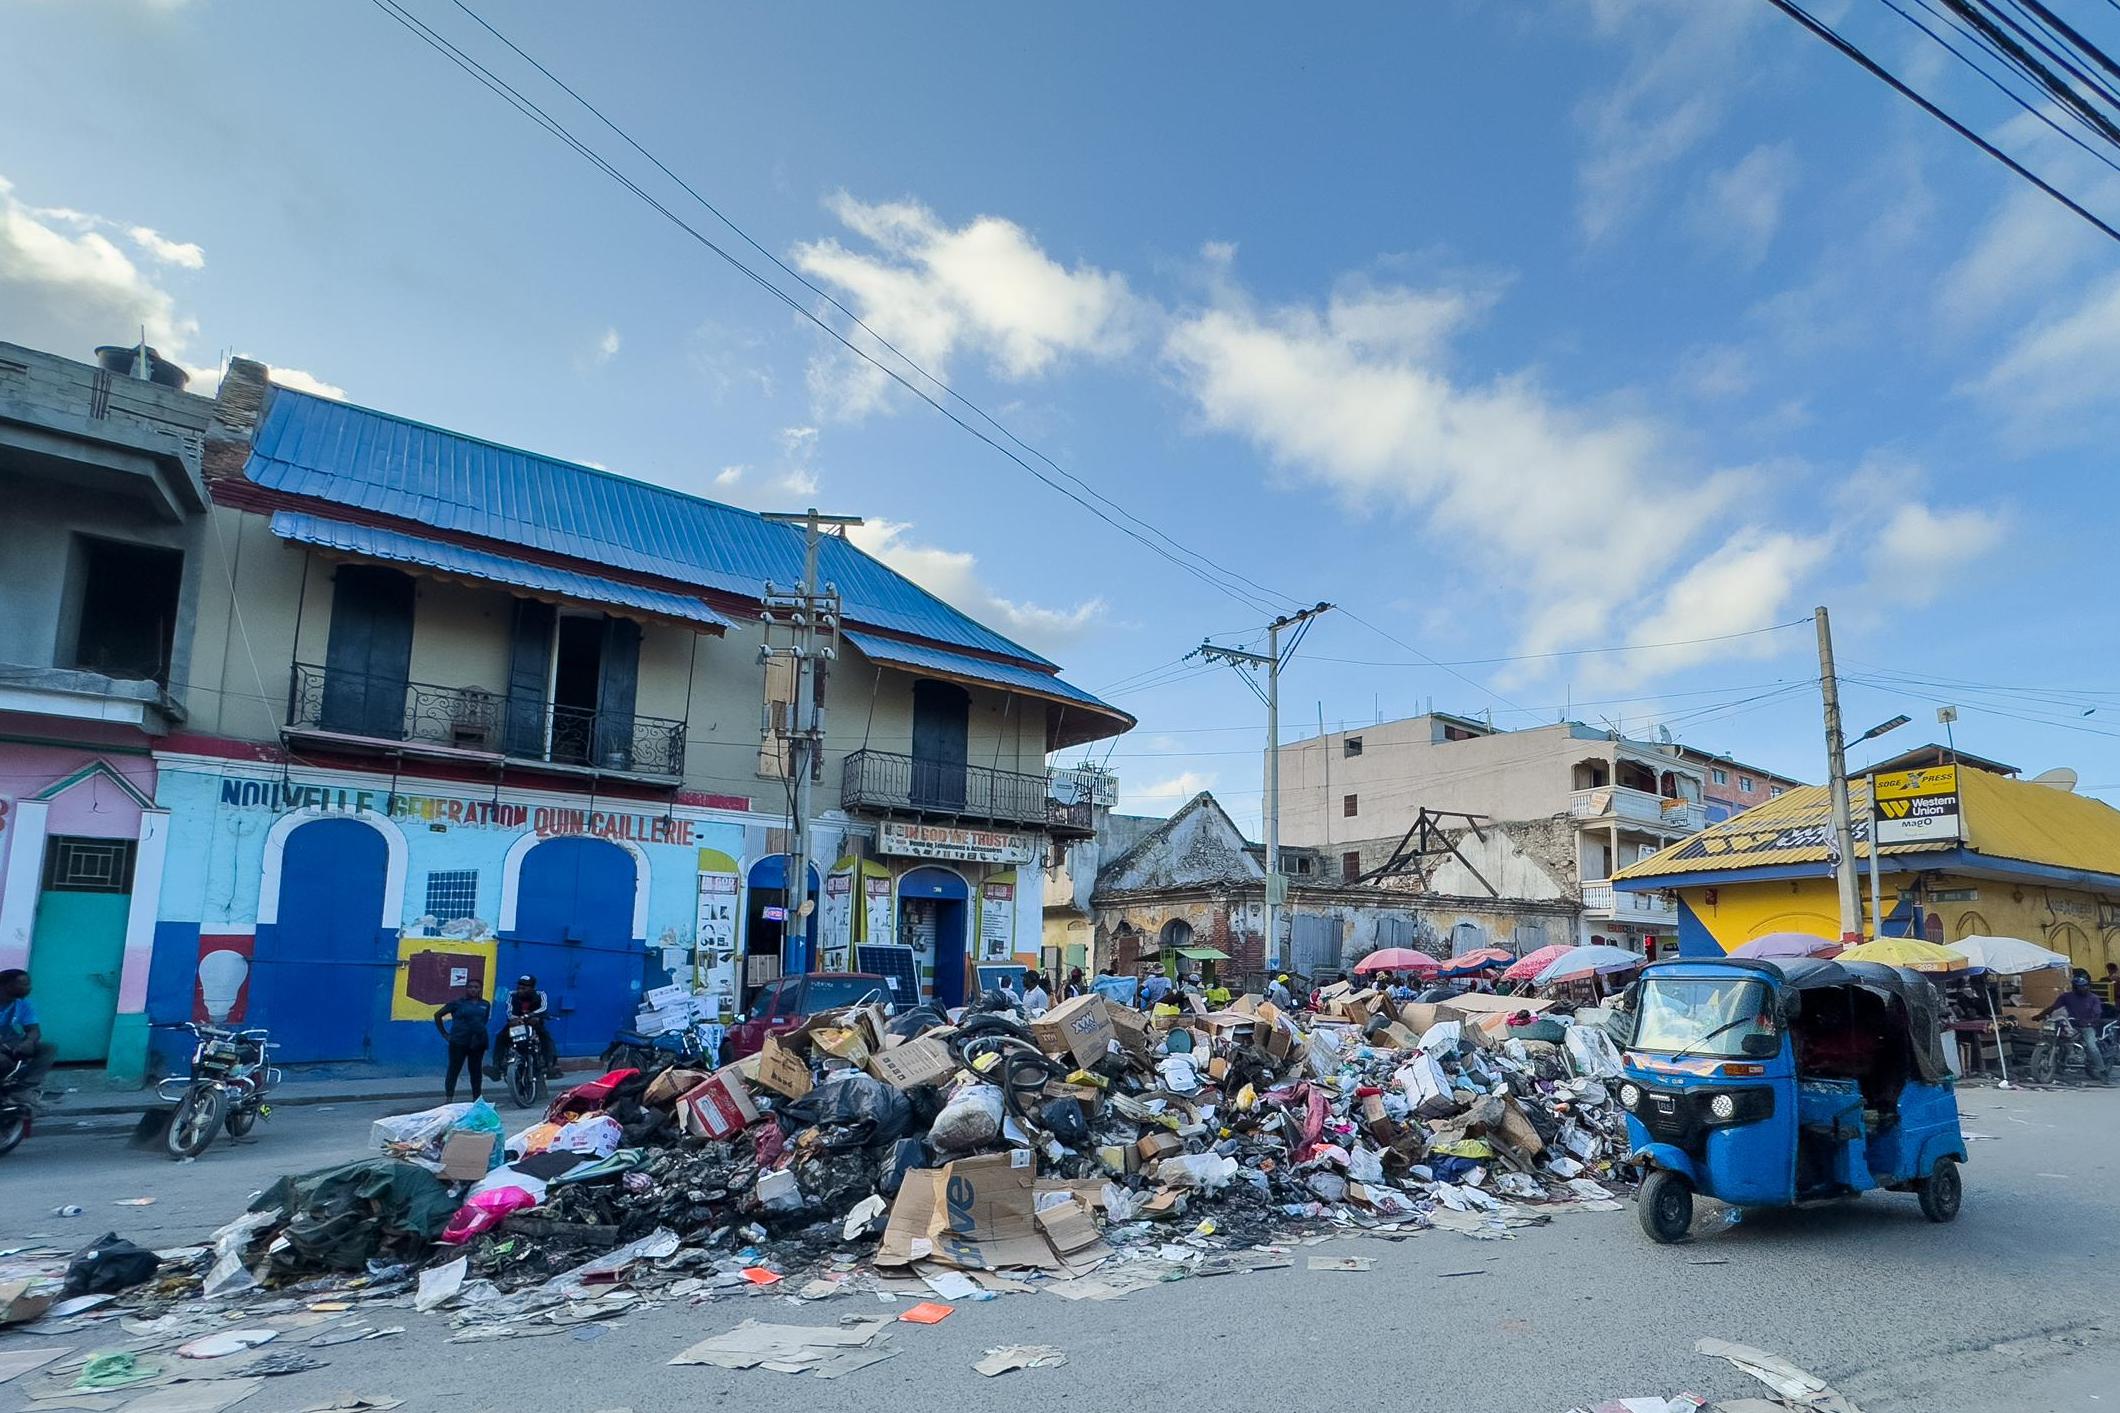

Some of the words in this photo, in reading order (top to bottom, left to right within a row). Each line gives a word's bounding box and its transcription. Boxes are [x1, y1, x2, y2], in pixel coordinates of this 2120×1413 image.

[221, 779, 375, 818] NOUVELLE
[1912, 797, 1955, 807] Western
[1912, 807, 1943, 816] Union
[921, 827, 947, 842] GOD
[971, 832, 1009, 847] TRUST
